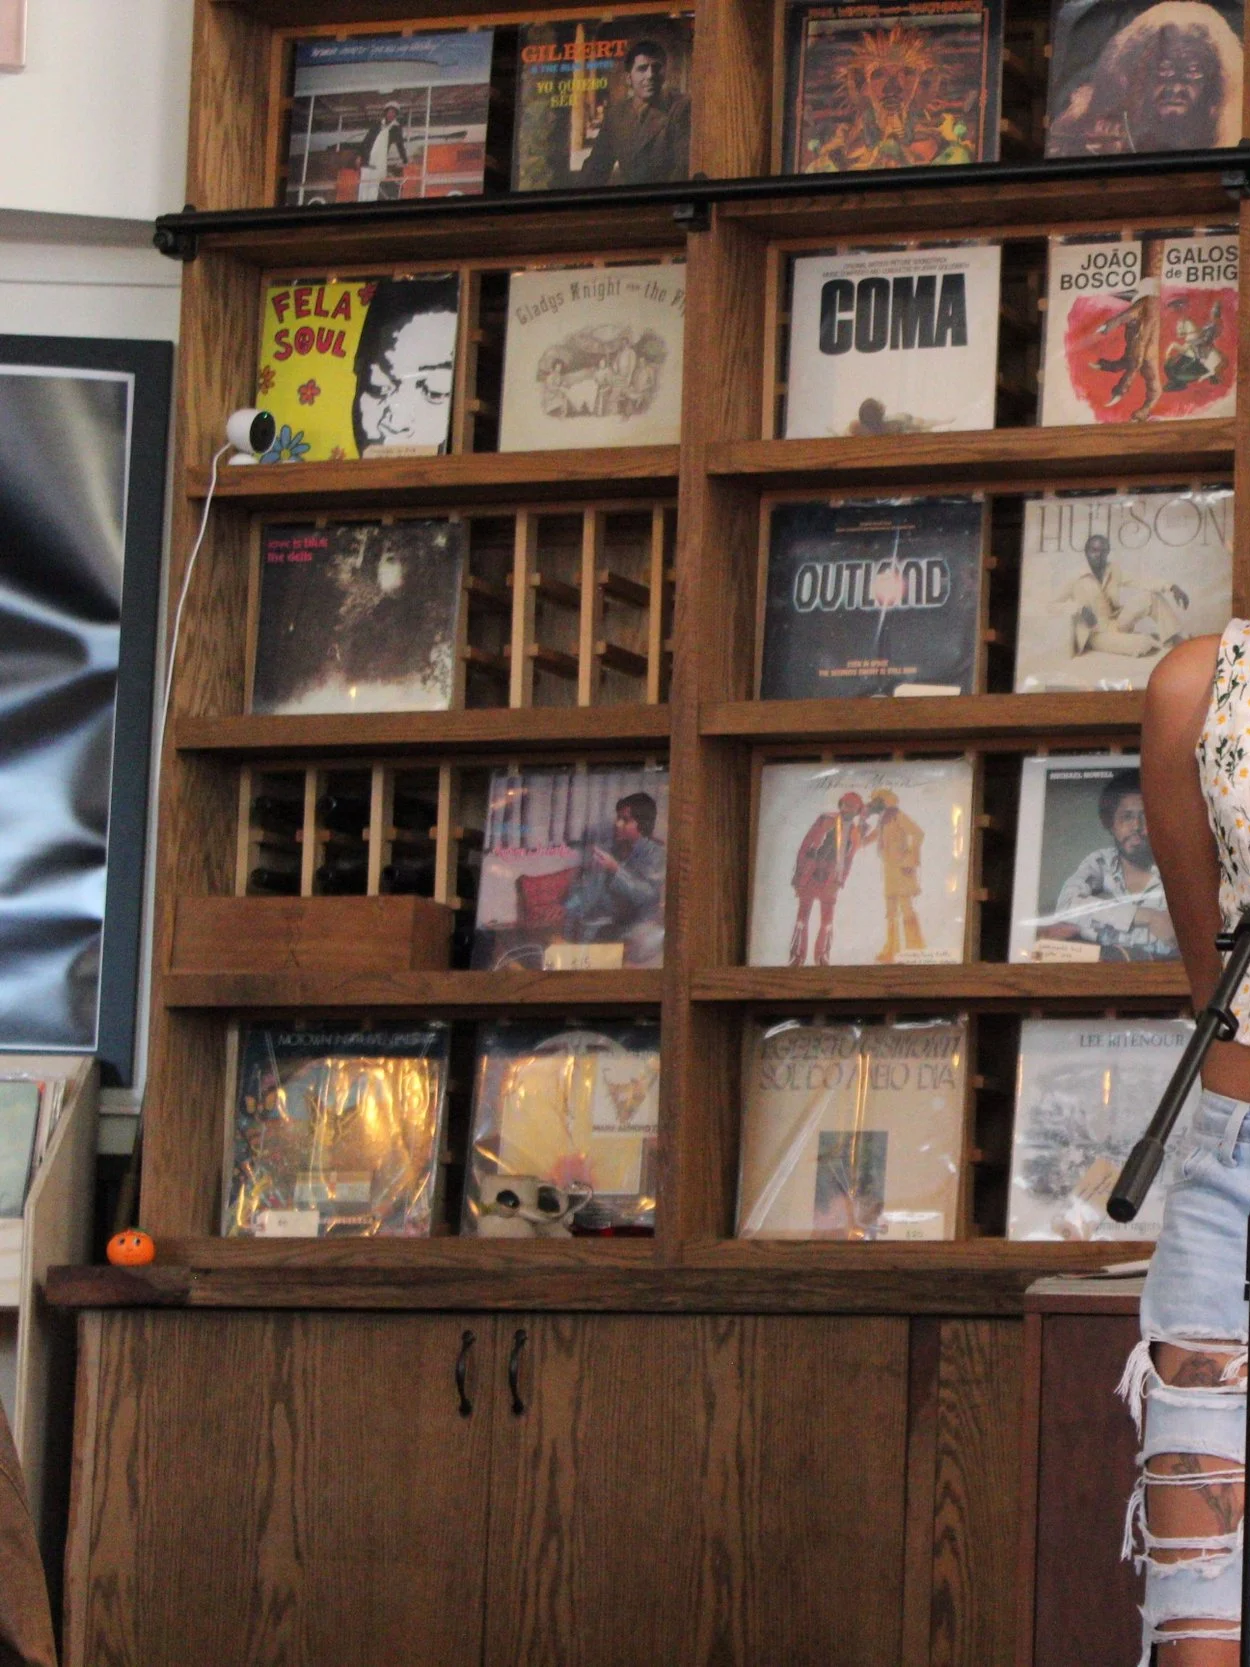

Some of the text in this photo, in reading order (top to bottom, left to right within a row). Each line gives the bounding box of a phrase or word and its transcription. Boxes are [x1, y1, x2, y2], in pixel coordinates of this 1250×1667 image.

[521, 39, 628, 63] GILBERT
[537, 81, 553, 94] YO
[1081, 249, 1138, 271] JOÃO
[1166, 245, 1239, 266] GALOS
[1060, 270, 1138, 291] BOSCO
[1165, 264, 1239, 283] de BRIG
[271, 286, 352, 324] FELA
[515, 291, 566, 326] Gladys
[570, 279, 627, 302] Knight
[643, 280, 668, 303] the
[819, 272, 968, 356] COMA
[272, 326, 347, 362] SOUL
[1037, 498, 1228, 553] HUTSON
